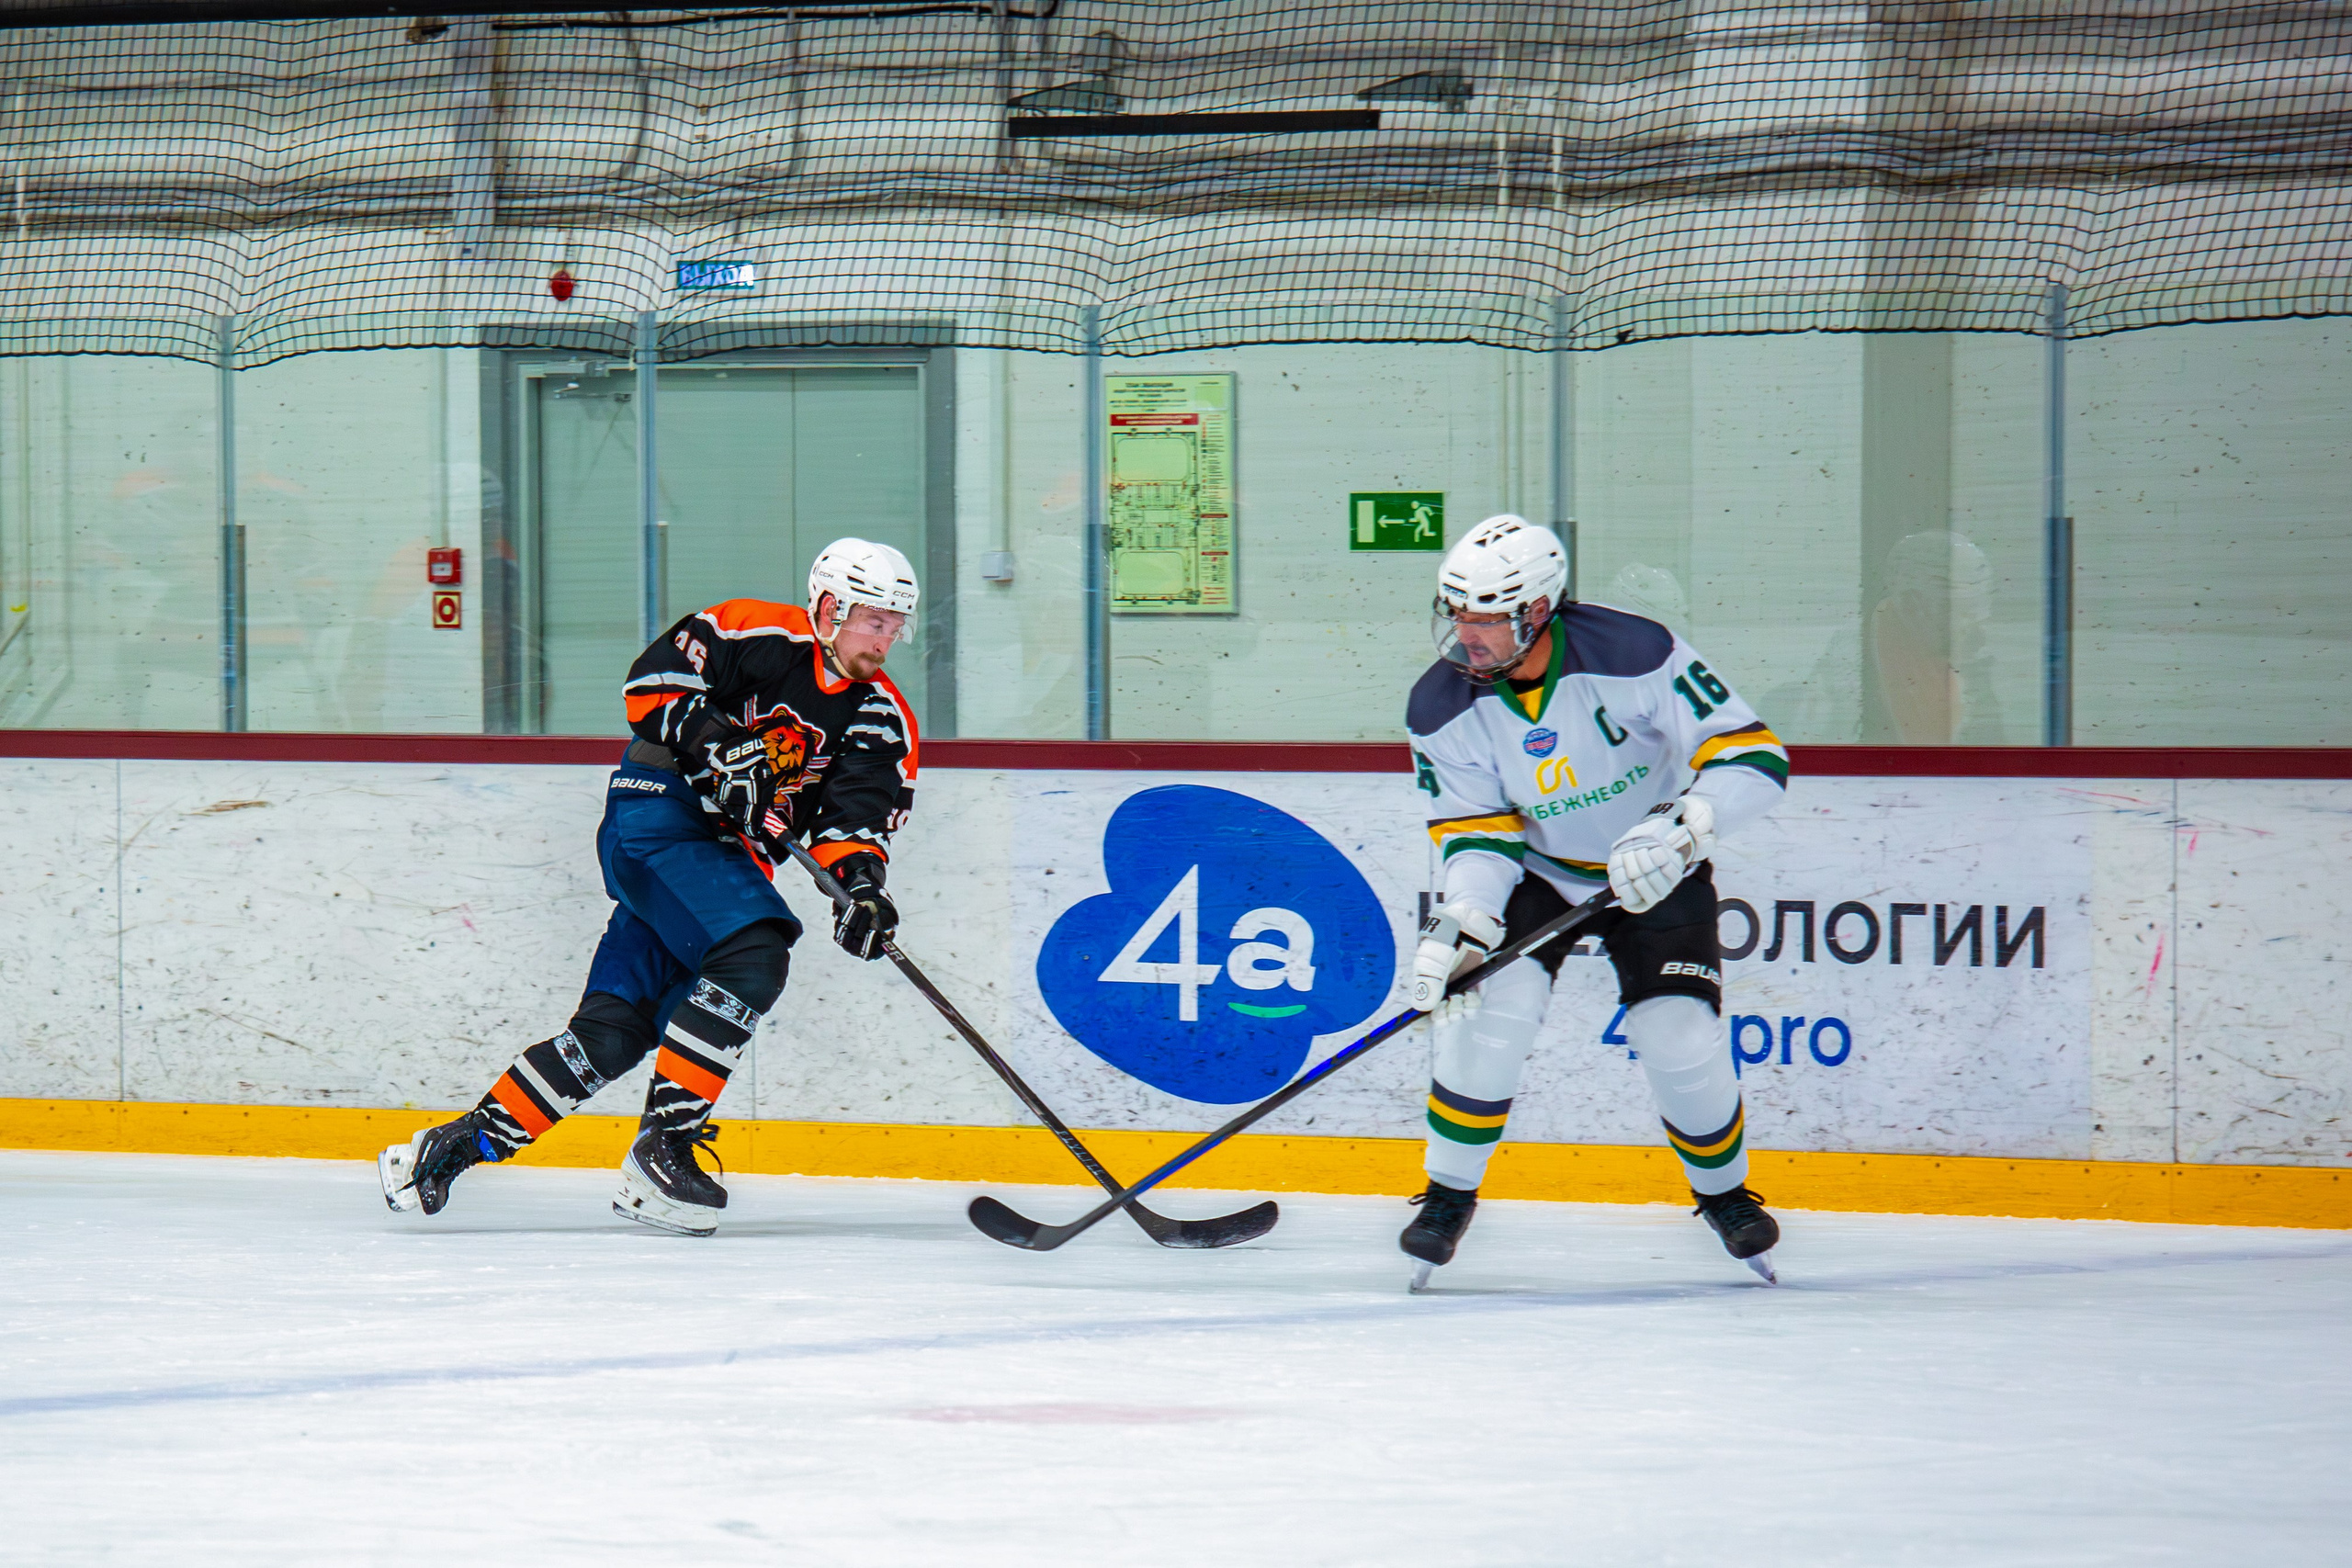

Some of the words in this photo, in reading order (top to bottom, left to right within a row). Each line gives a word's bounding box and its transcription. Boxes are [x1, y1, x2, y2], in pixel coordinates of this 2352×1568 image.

[679, 264, 754, 287] ВЫХОД
[892, 590, 916, 601] CCM
[1673, 660, 1730, 721] 16
[1594, 705, 1629, 747] C
